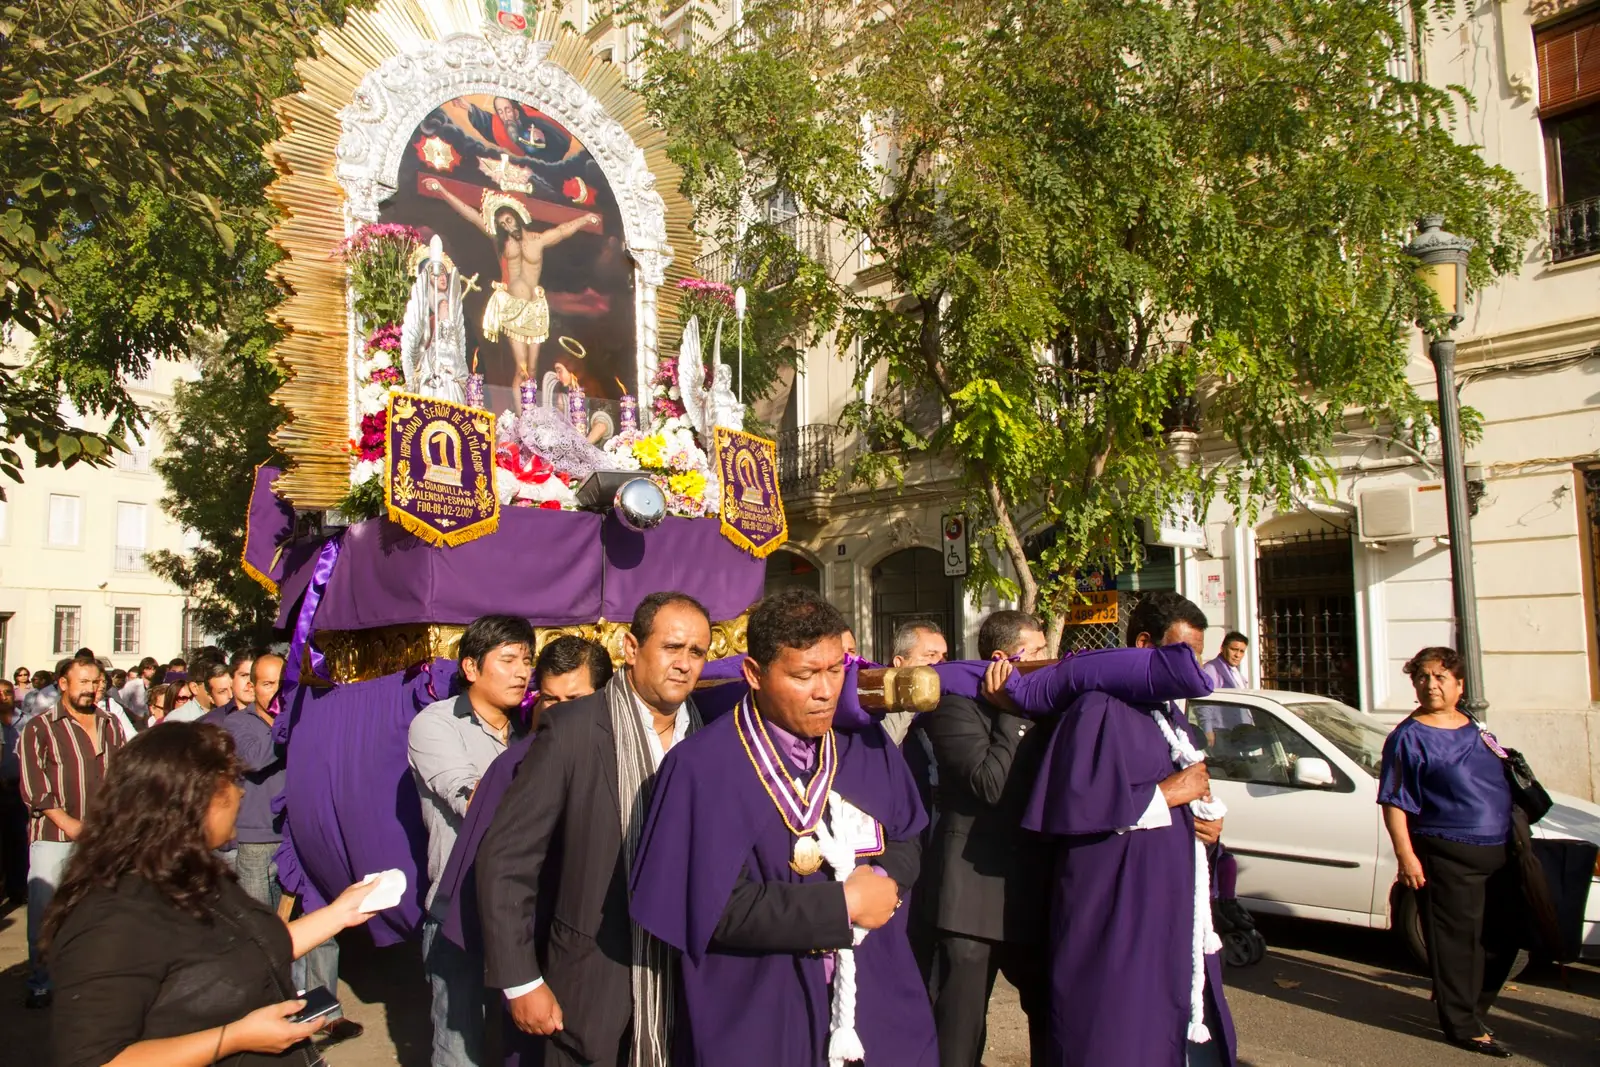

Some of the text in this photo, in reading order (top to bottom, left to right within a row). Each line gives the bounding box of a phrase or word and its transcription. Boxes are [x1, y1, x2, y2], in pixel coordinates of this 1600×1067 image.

[400, 416, 423, 458] HERMANDAD
[423, 404, 451, 419] SEÑOR
[451, 411, 464, 425] DE
[460, 421, 474, 436] LOS
[431, 432, 450, 468] 1
[424, 480, 464, 496] CUADRILLA
[741, 458, 756, 489] 1
[1096, 607, 1116, 620] 732
